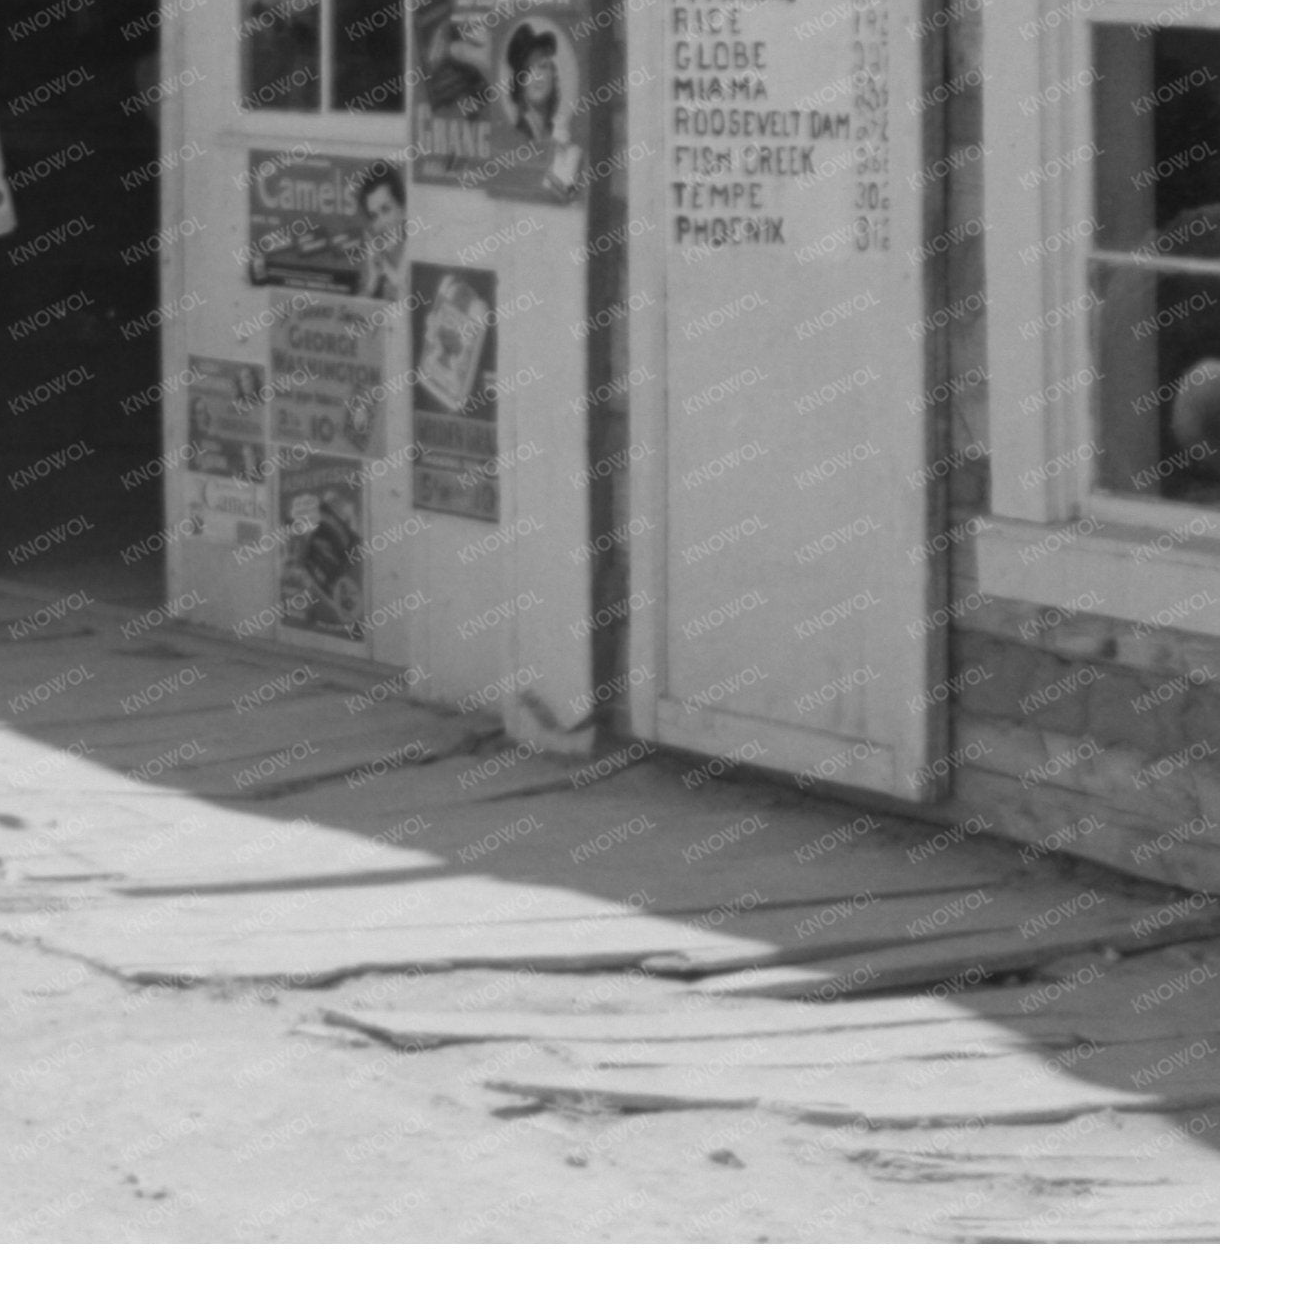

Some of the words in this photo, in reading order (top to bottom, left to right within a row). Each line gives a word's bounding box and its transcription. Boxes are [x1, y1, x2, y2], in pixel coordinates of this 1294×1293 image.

[672, 7, 741, 36] RICE
[674, 41, 767, 72] GLOBE
[673, 107, 801, 137] ROOSEVELT
[809, 108, 852, 140] DAM
[674, 145, 732, 176] FISH
[743, 145, 815, 177] CREEK
[257, 167, 358, 216] Camels
[671, 181, 765, 210] TEMPE
[674, 214, 785, 246] PHOENIX
[287, 325, 358, 355] GEORGE
[270, 348, 382, 386] WASHINGTON
